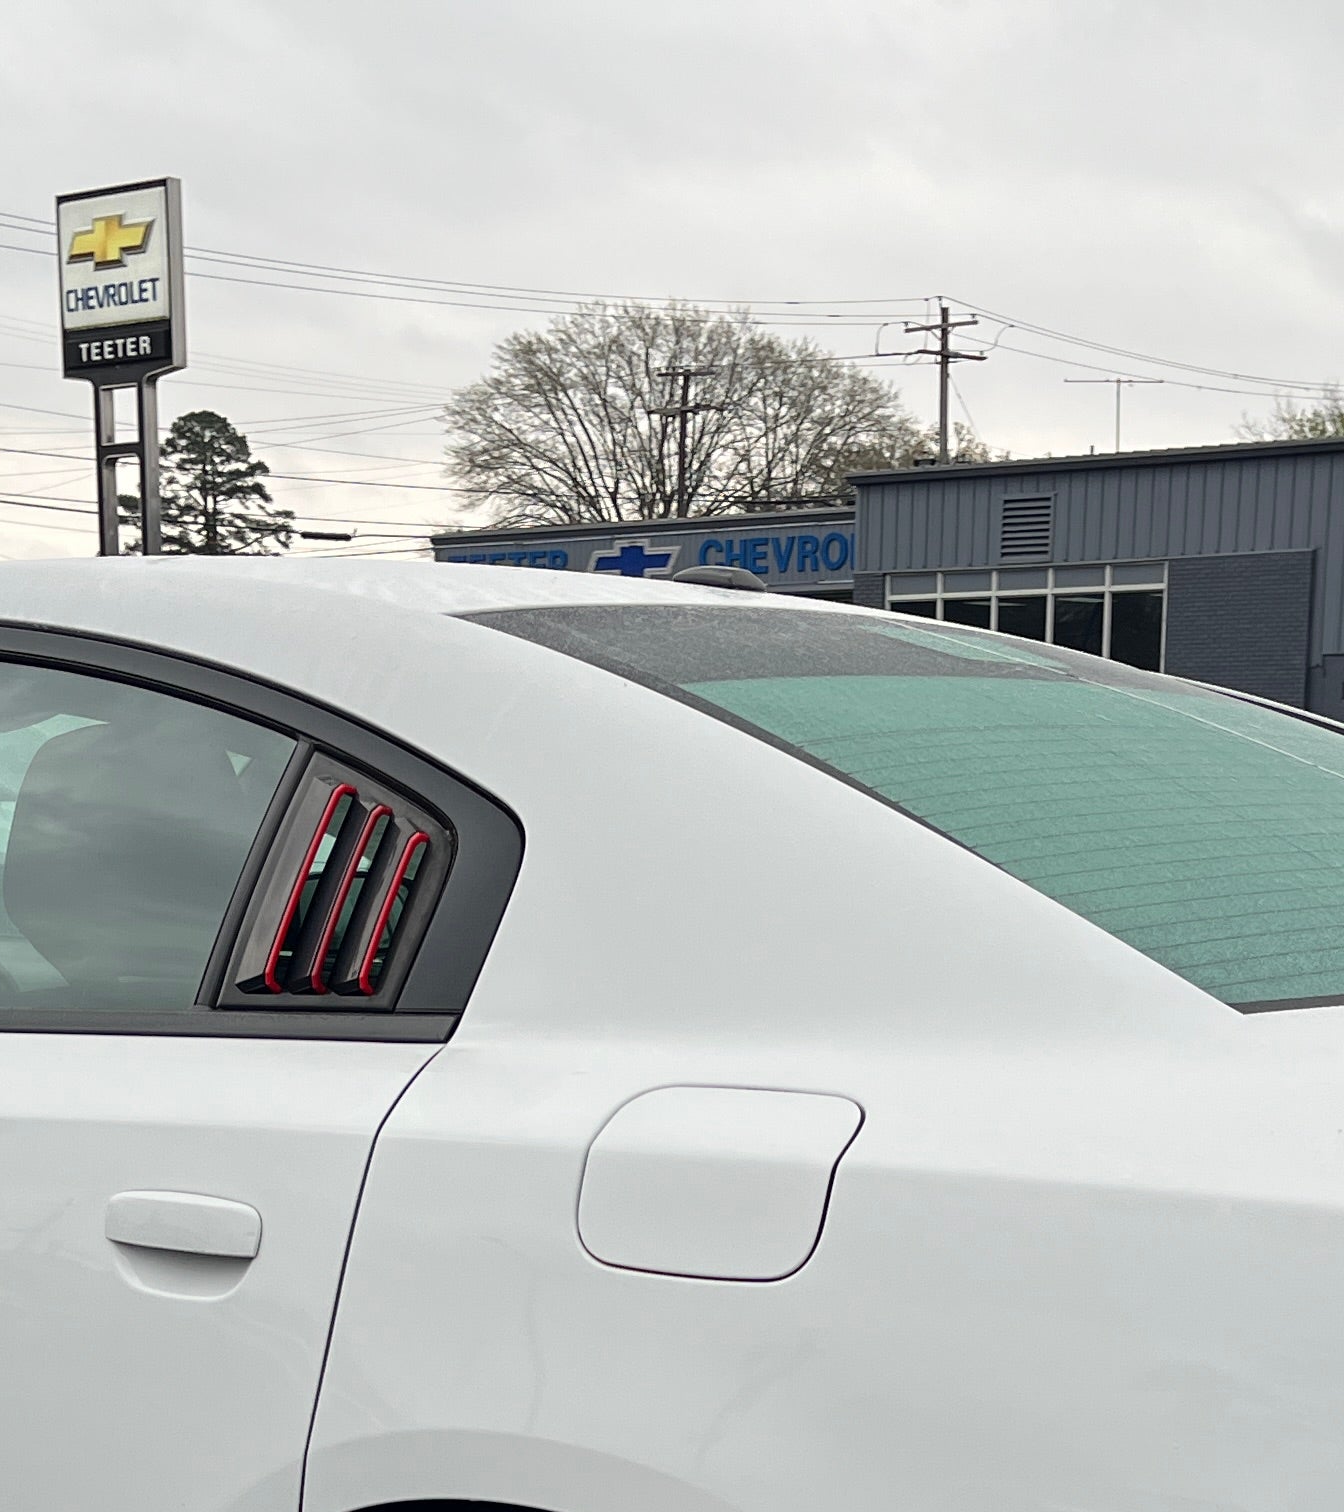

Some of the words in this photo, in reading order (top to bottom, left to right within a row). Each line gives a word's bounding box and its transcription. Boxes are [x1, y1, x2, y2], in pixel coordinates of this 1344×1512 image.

[66, 278, 160, 313] CHEVROLET
[78, 336, 152, 362] TEETER
[698, 531, 855, 575] CHEVRO
